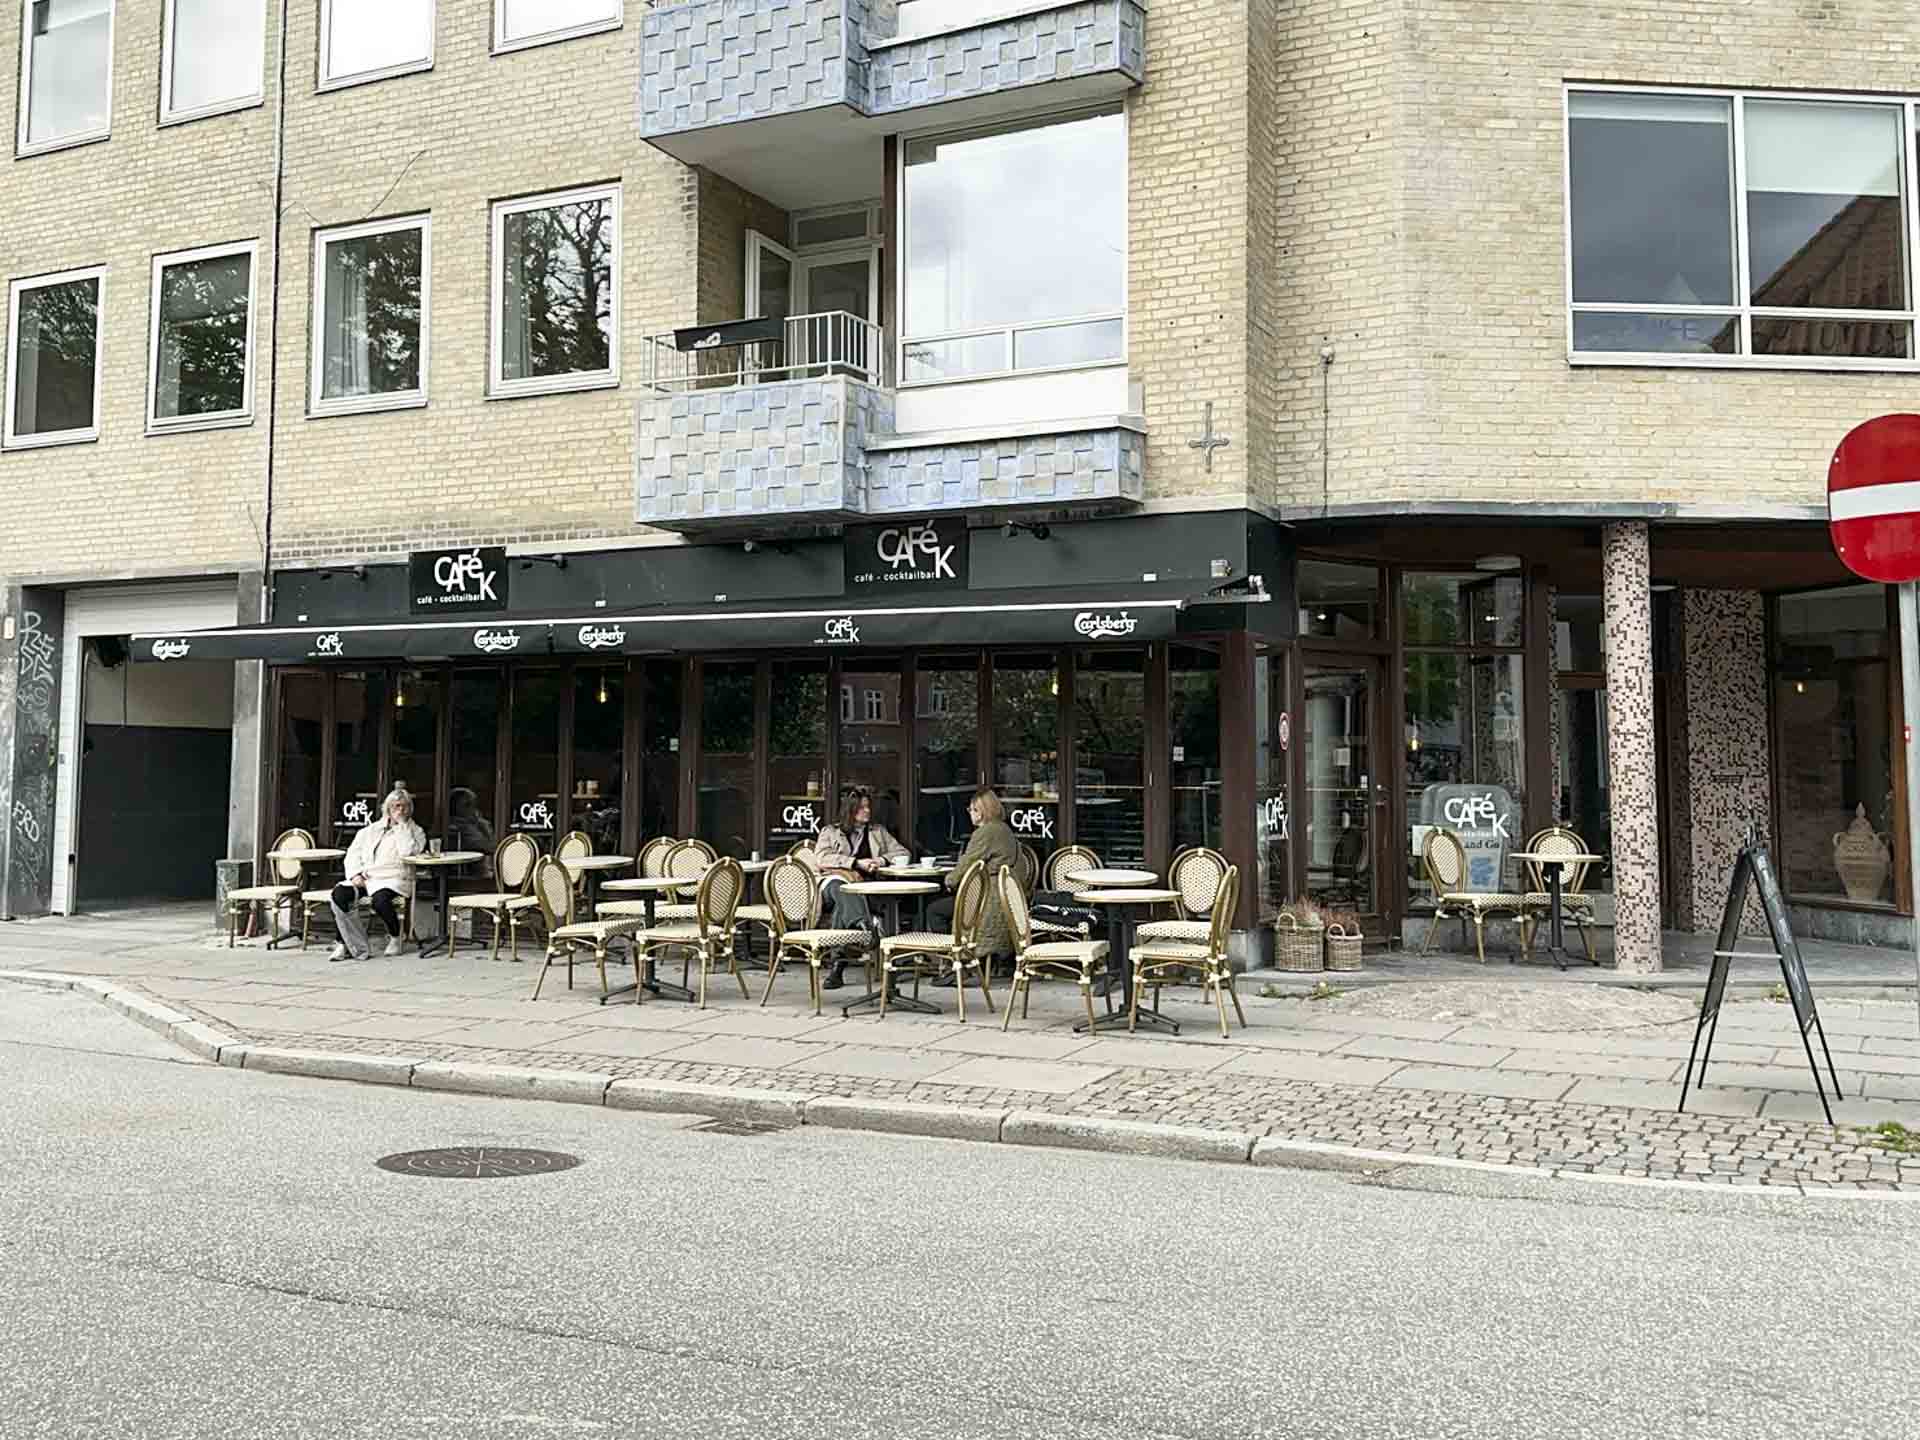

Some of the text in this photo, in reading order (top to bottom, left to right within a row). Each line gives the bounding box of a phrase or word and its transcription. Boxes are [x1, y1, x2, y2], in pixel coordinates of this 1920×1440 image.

[935, 545, 956, 579] K
[480, 570, 498, 601] K
[883, 571, 935, 581] cocktailbar
[578, 624, 626, 649] Carlsberg
[850, 627, 860, 643] K
[1074, 611, 1138, 639] Carlsberg
[473, 629, 520, 653] Carlsberg
[544, 812, 554, 829] K
[810, 816, 821, 833] K
[1042, 820, 1054, 839] K
[1492, 813, 1510, 838] K
